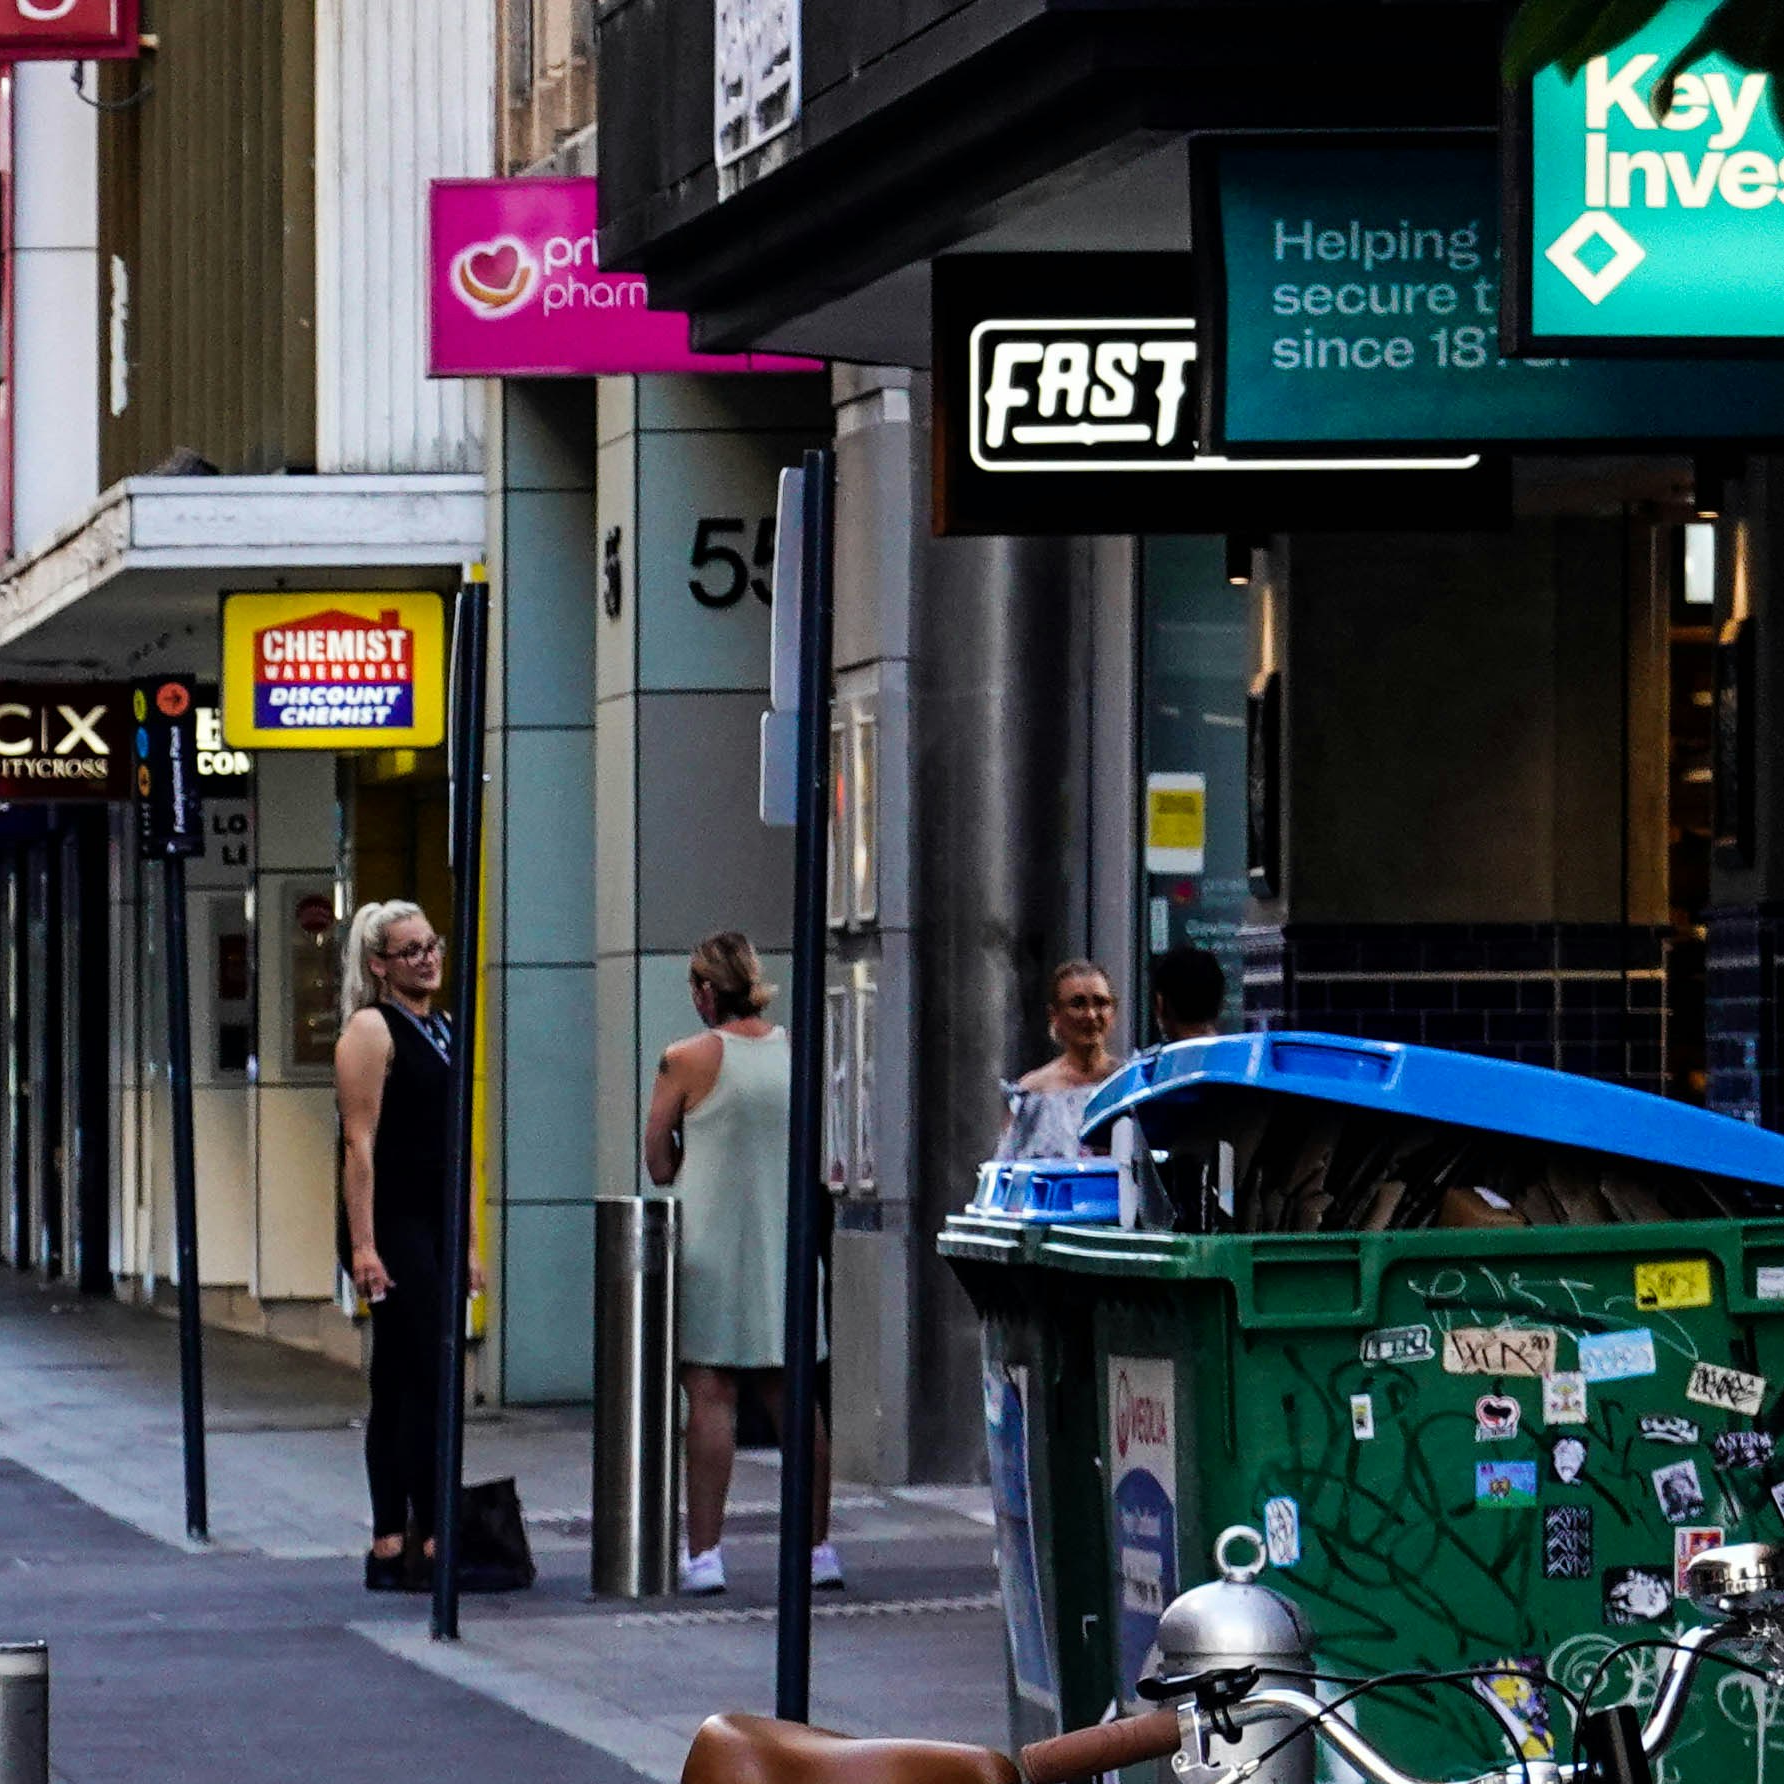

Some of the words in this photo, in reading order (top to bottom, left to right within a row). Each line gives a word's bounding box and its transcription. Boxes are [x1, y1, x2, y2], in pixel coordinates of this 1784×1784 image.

[1587, 54, 1767, 144] Key
[1587, 131, 1784, 210] Inve
[1272, 219, 1481, 271] Helping
[1272, 285, 1460, 316] secure
[1272, 327, 1415, 370] since
[984, 342, 1196, 449] FAST
[262, 628, 409, 664] CHEMIST
[268, 684, 403, 707] DISCOUNT
[279, 705, 392, 727] CHEMIST
